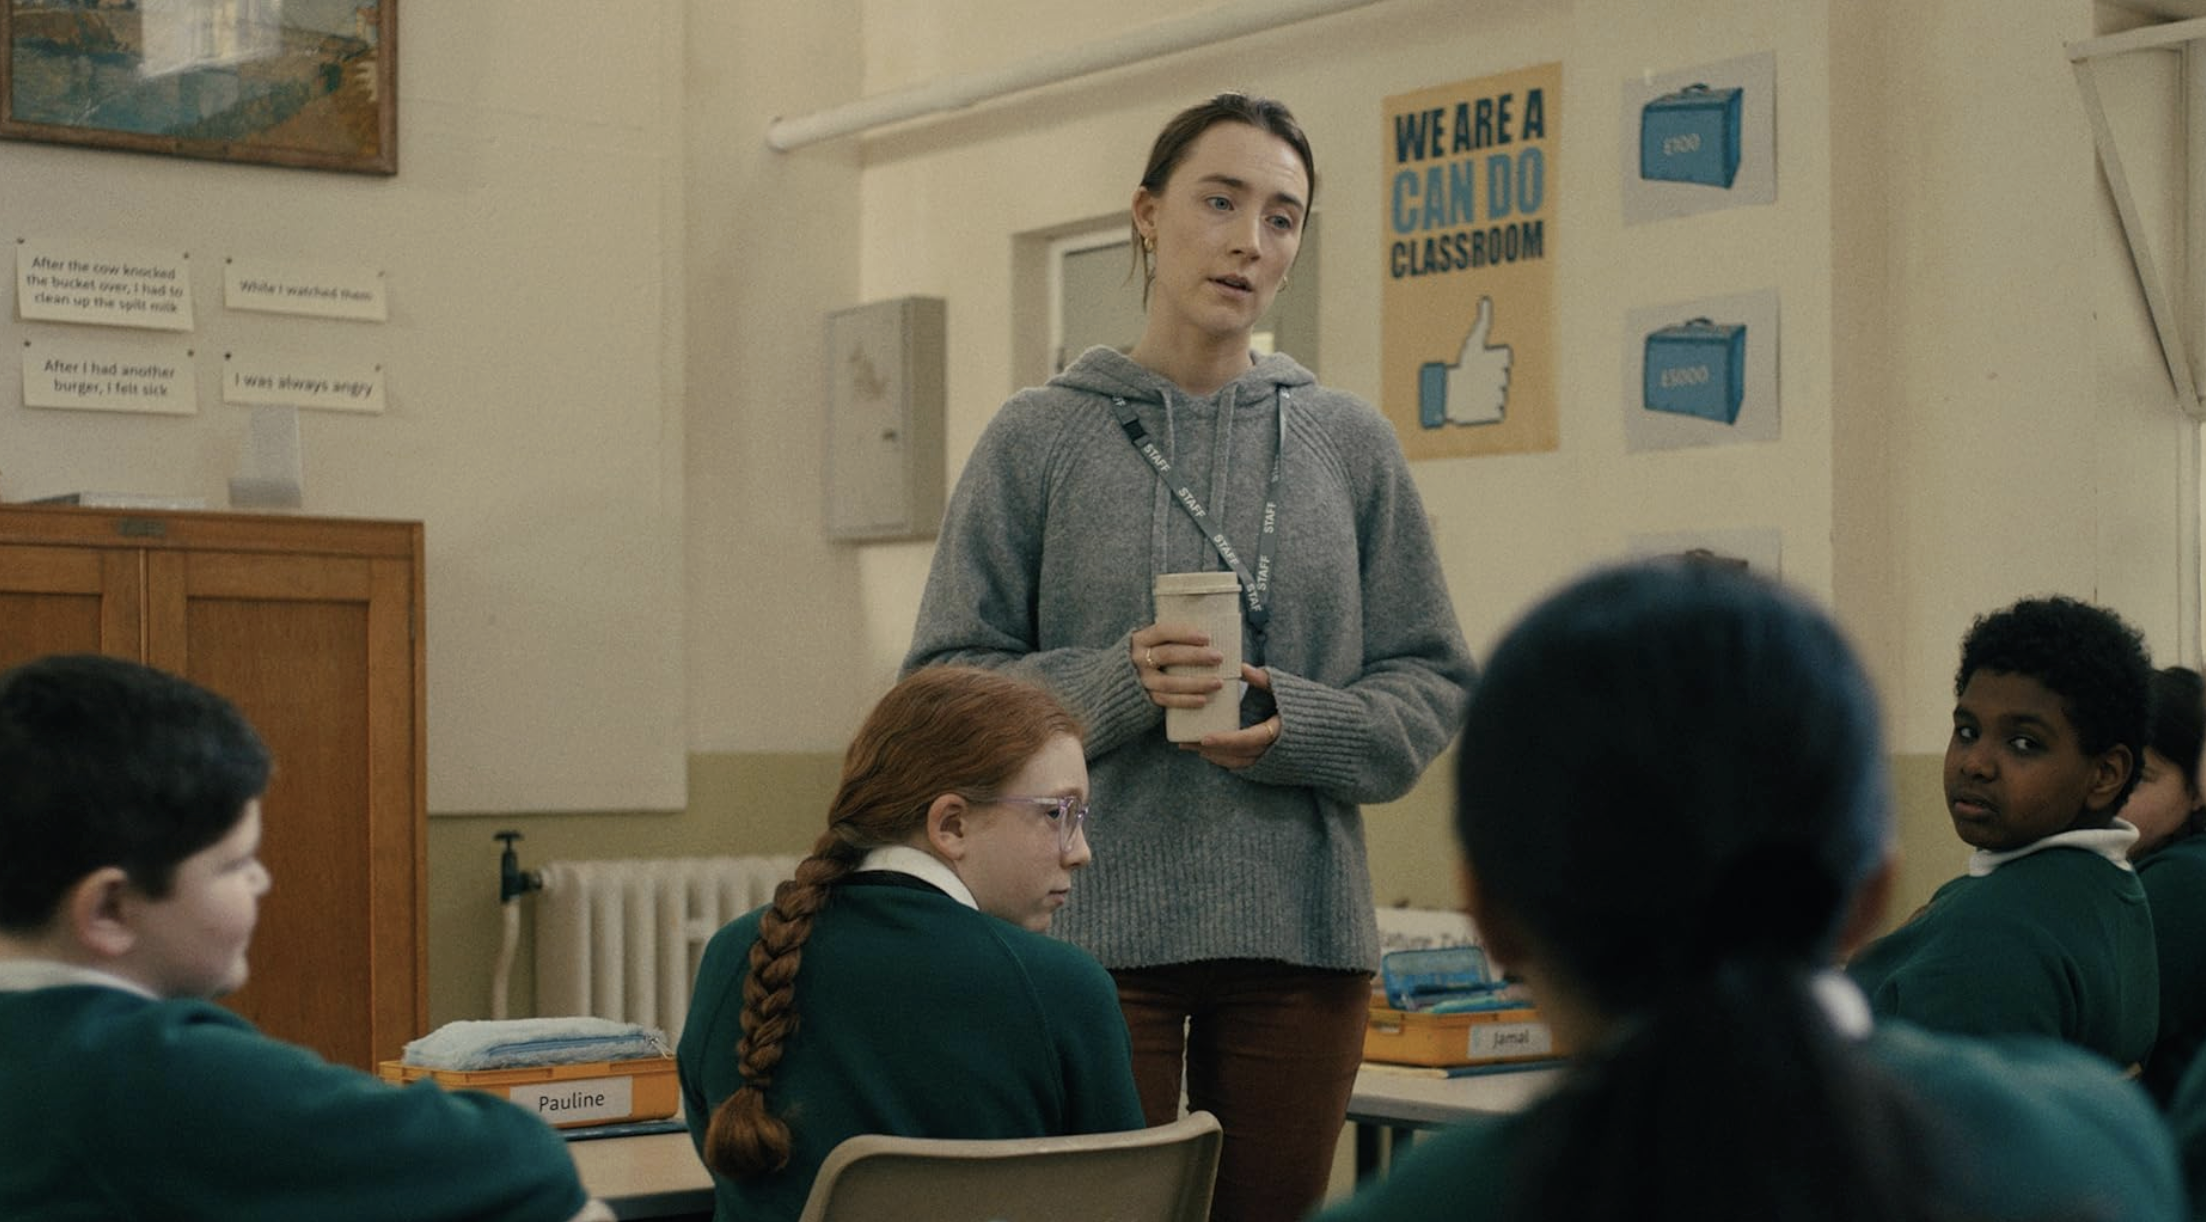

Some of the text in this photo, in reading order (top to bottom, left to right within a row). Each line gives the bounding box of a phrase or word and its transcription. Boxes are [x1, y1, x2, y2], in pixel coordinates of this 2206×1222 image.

[1395, 88, 1545, 163] WE ARE A
[1392, 147, 1544, 234] CAN DO
[1391, 220, 1544, 279] CLASSROOM
[32, 256, 176, 280] After the cow knocked
[26, 274, 48, 286] the
[52, 275, 96, 290] bucket
[99, 281, 130, 295] over,
[142, 283, 166, 297] had
[169, 286, 183, 298] to
[240, 280, 275, 293] While
[286, 285, 338, 299] watched
[34, 291, 69, 305] clean
[73, 297, 90, 308] up
[94, 297, 115, 308] the
[149, 302, 177, 313] milk
[44, 359, 78, 373] After
[91, 362, 117, 376] had
[121, 365, 175, 378] another
[54, 379, 102, 397] burger,
[115, 381, 138, 396] felt
[142, 382, 168, 397] sick
[235, 372, 373, 398] I was always angry
[1143, 443, 1171, 473] STAFF
[1178, 487, 1206, 518] STAFF
[1264, 502, 1276, 533] STAFF
[1213, 534, 1240, 566] STAFF
[1257, 555, 1270, 591] STAFF
[1246, 583, 1262, 612] STAF
[1492, 1030, 1530, 1049] Jamal
[538, 1092, 605, 1113] Pauline
